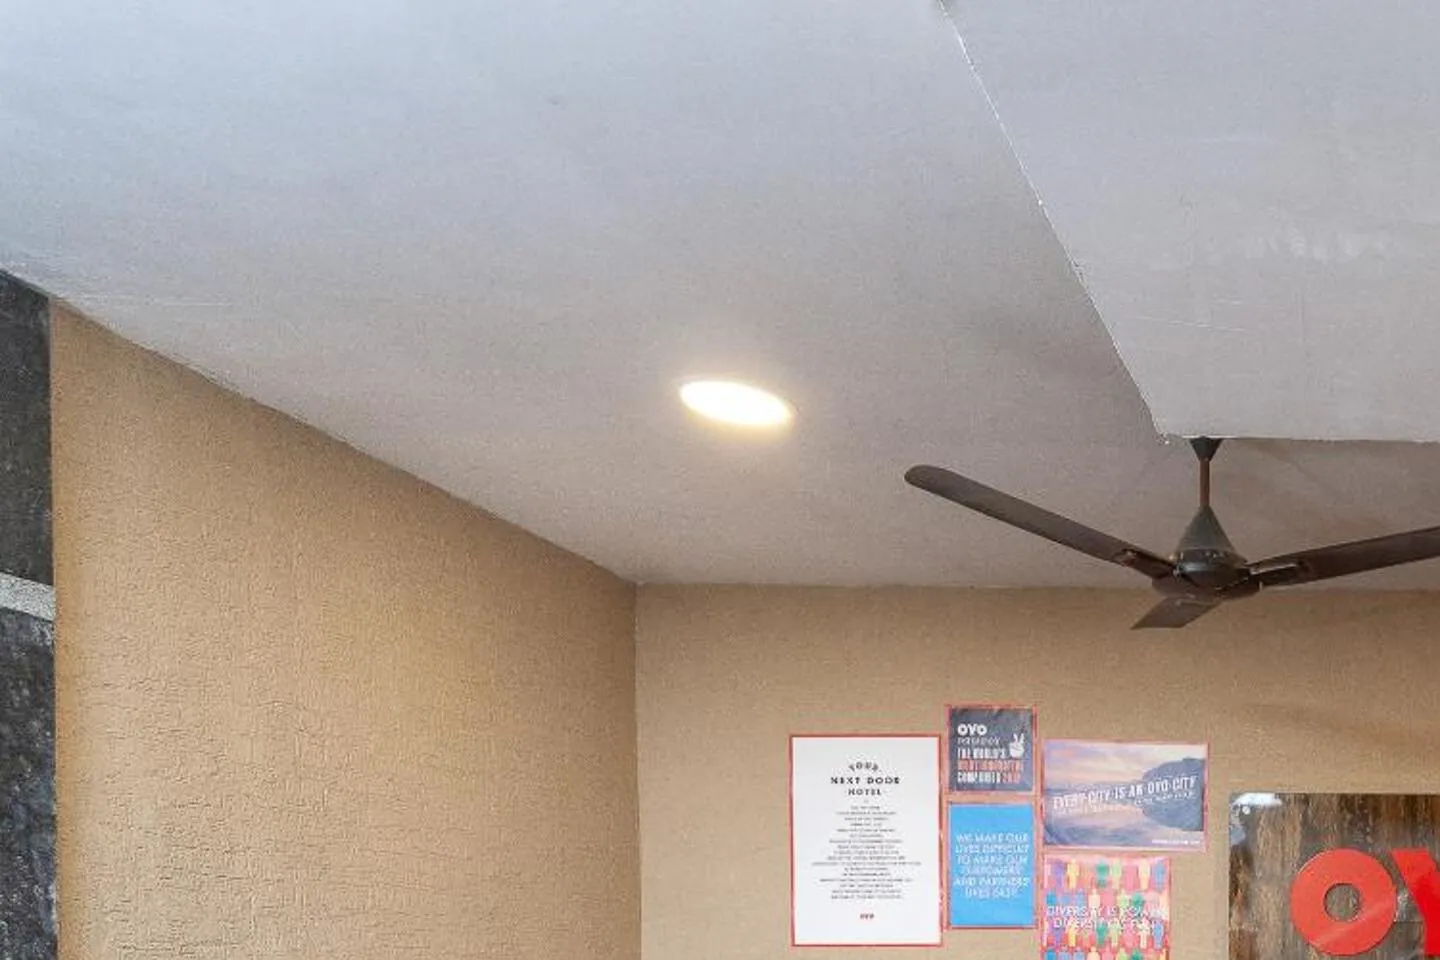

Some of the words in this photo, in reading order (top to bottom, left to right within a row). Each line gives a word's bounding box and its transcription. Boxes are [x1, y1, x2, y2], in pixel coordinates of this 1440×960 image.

[957, 723, 988, 736] OYO
[830, 776, 861, 785] NEXT
[848, 787, 881, 796] HOTEL
[1088, 789, 1111, 805] CITY
[1114, 785, 1126, 799] IS
[1128, 783, 1144, 798] AN
[1147, 779, 1169, 795] OYO
[1172, 776, 1197, 791] CITY
